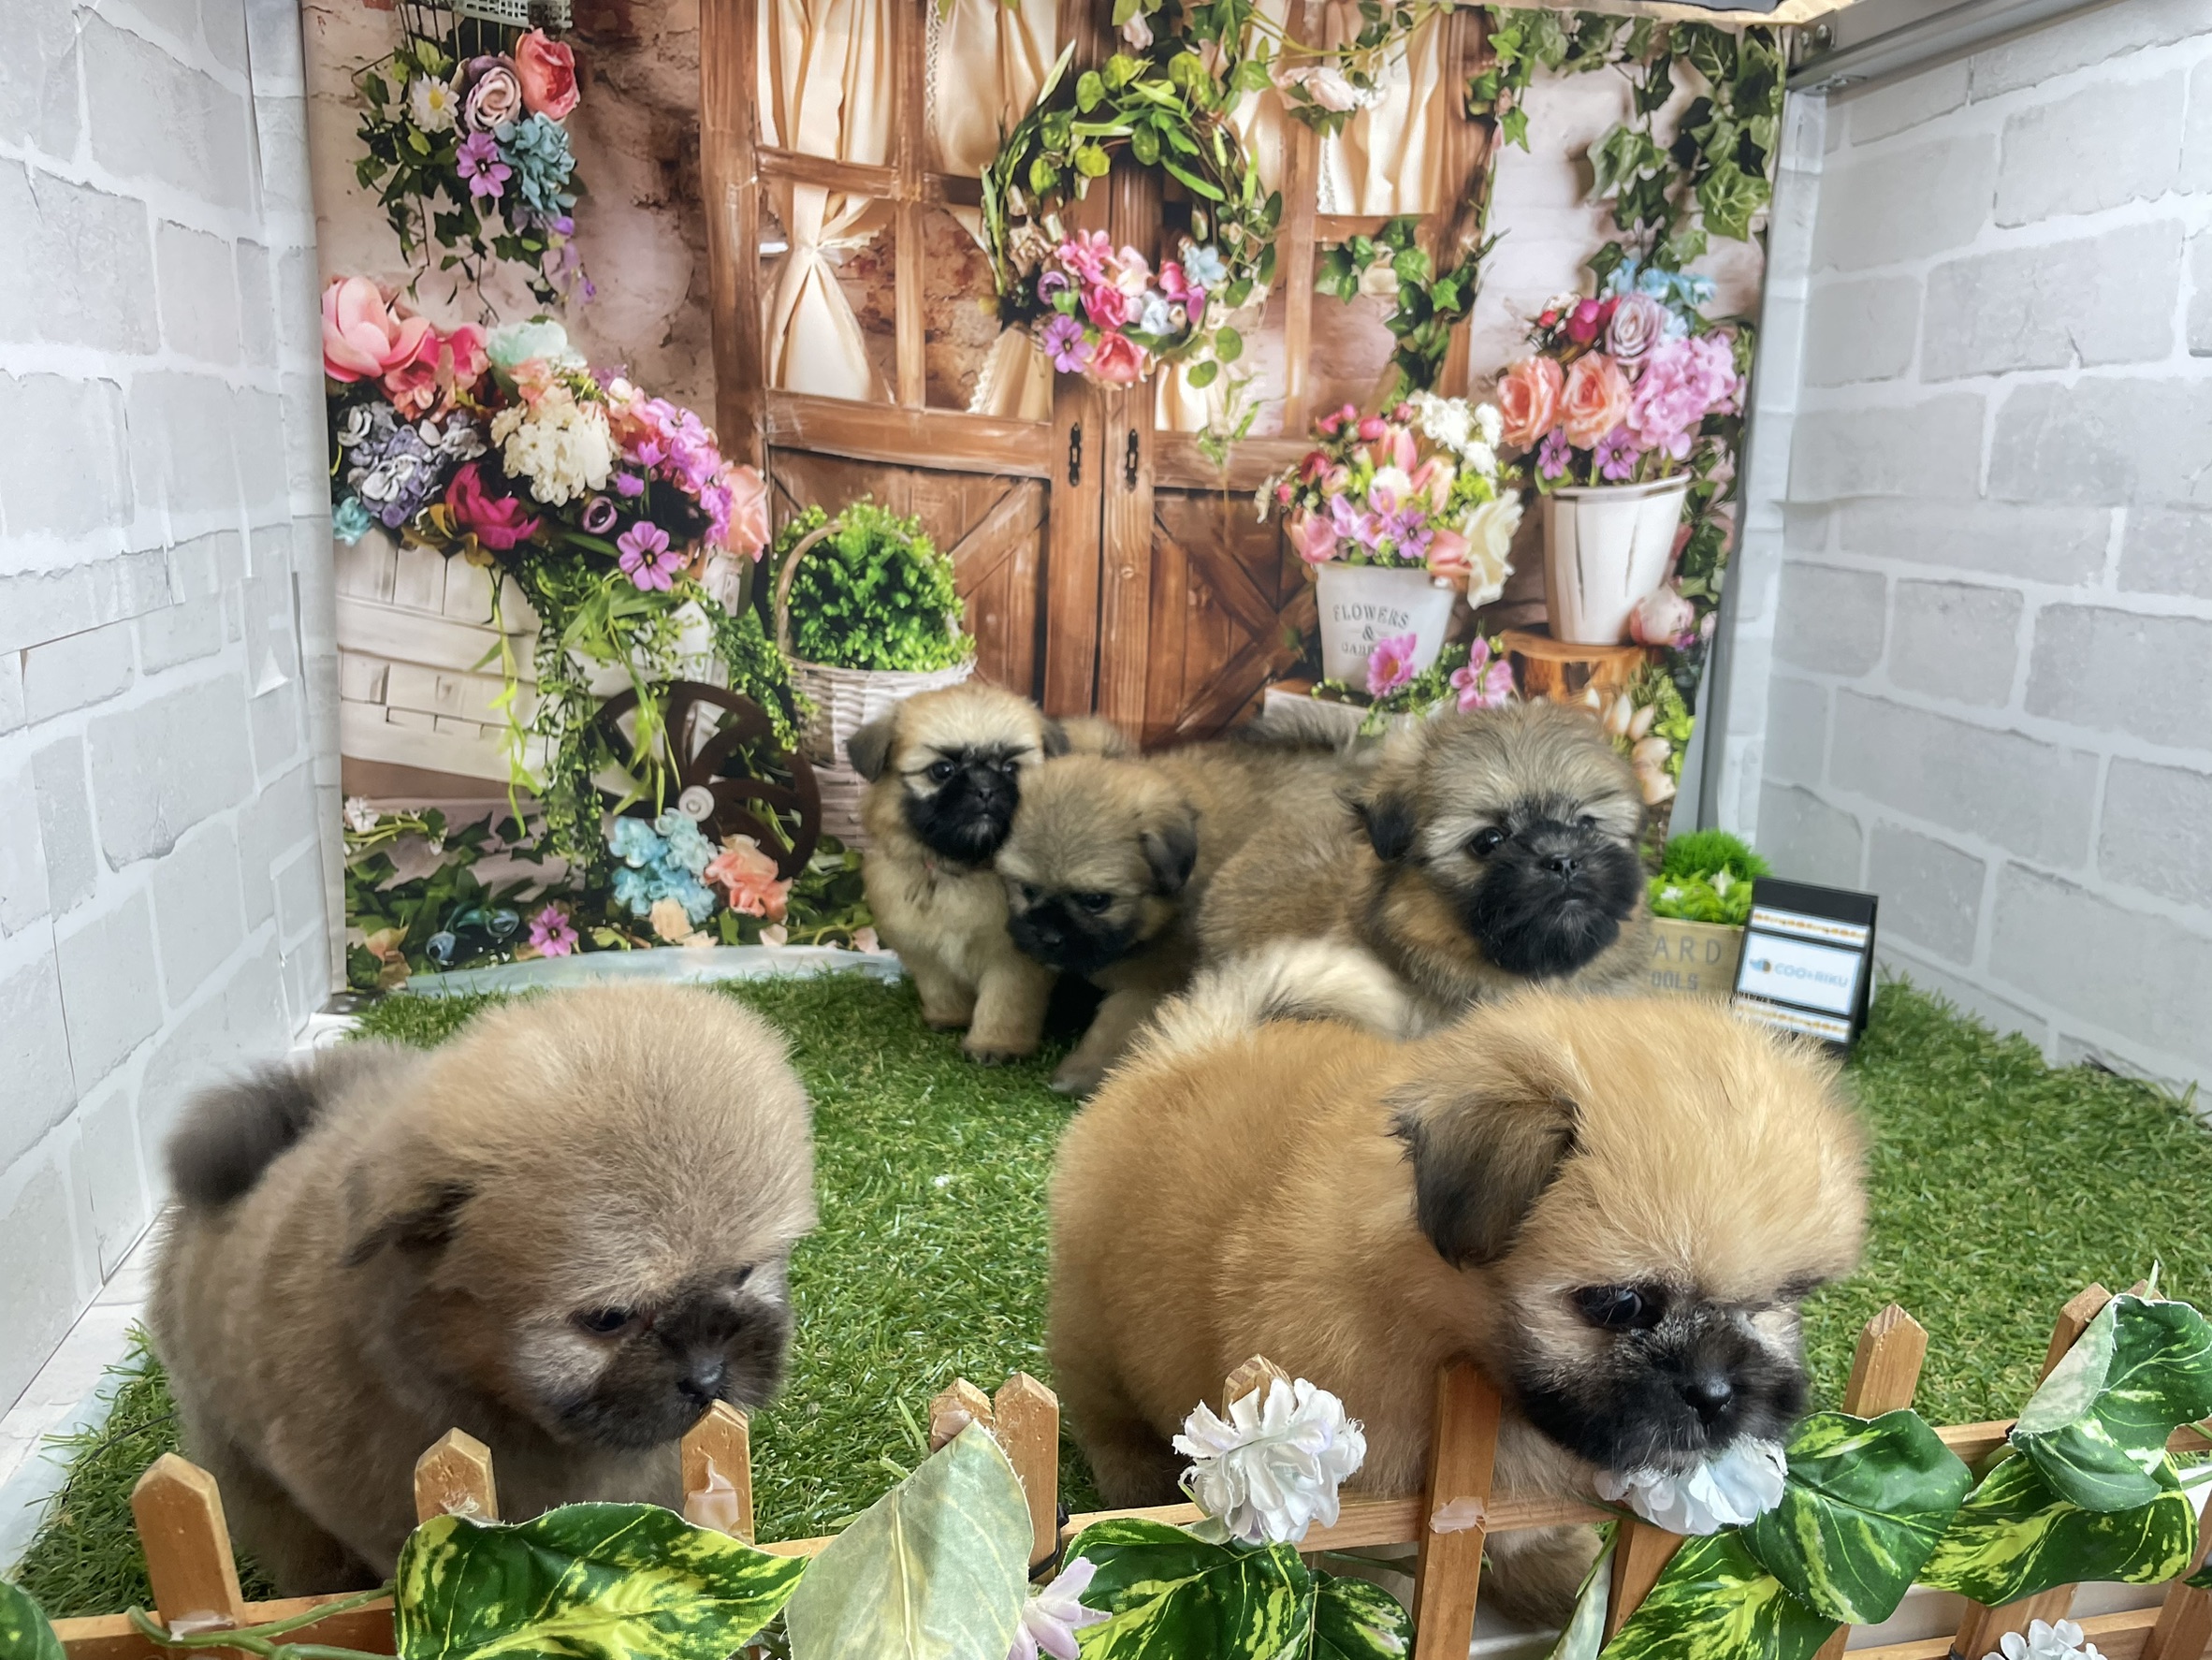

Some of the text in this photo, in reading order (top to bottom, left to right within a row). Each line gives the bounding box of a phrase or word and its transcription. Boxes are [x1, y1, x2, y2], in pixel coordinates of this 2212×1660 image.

[1333, 604, 1410, 629] FLOWERS
[1362, 624, 1375, 641] &
[1652, 934, 1722, 966] ARD
[1651, 970, 1698, 990] OOLS
